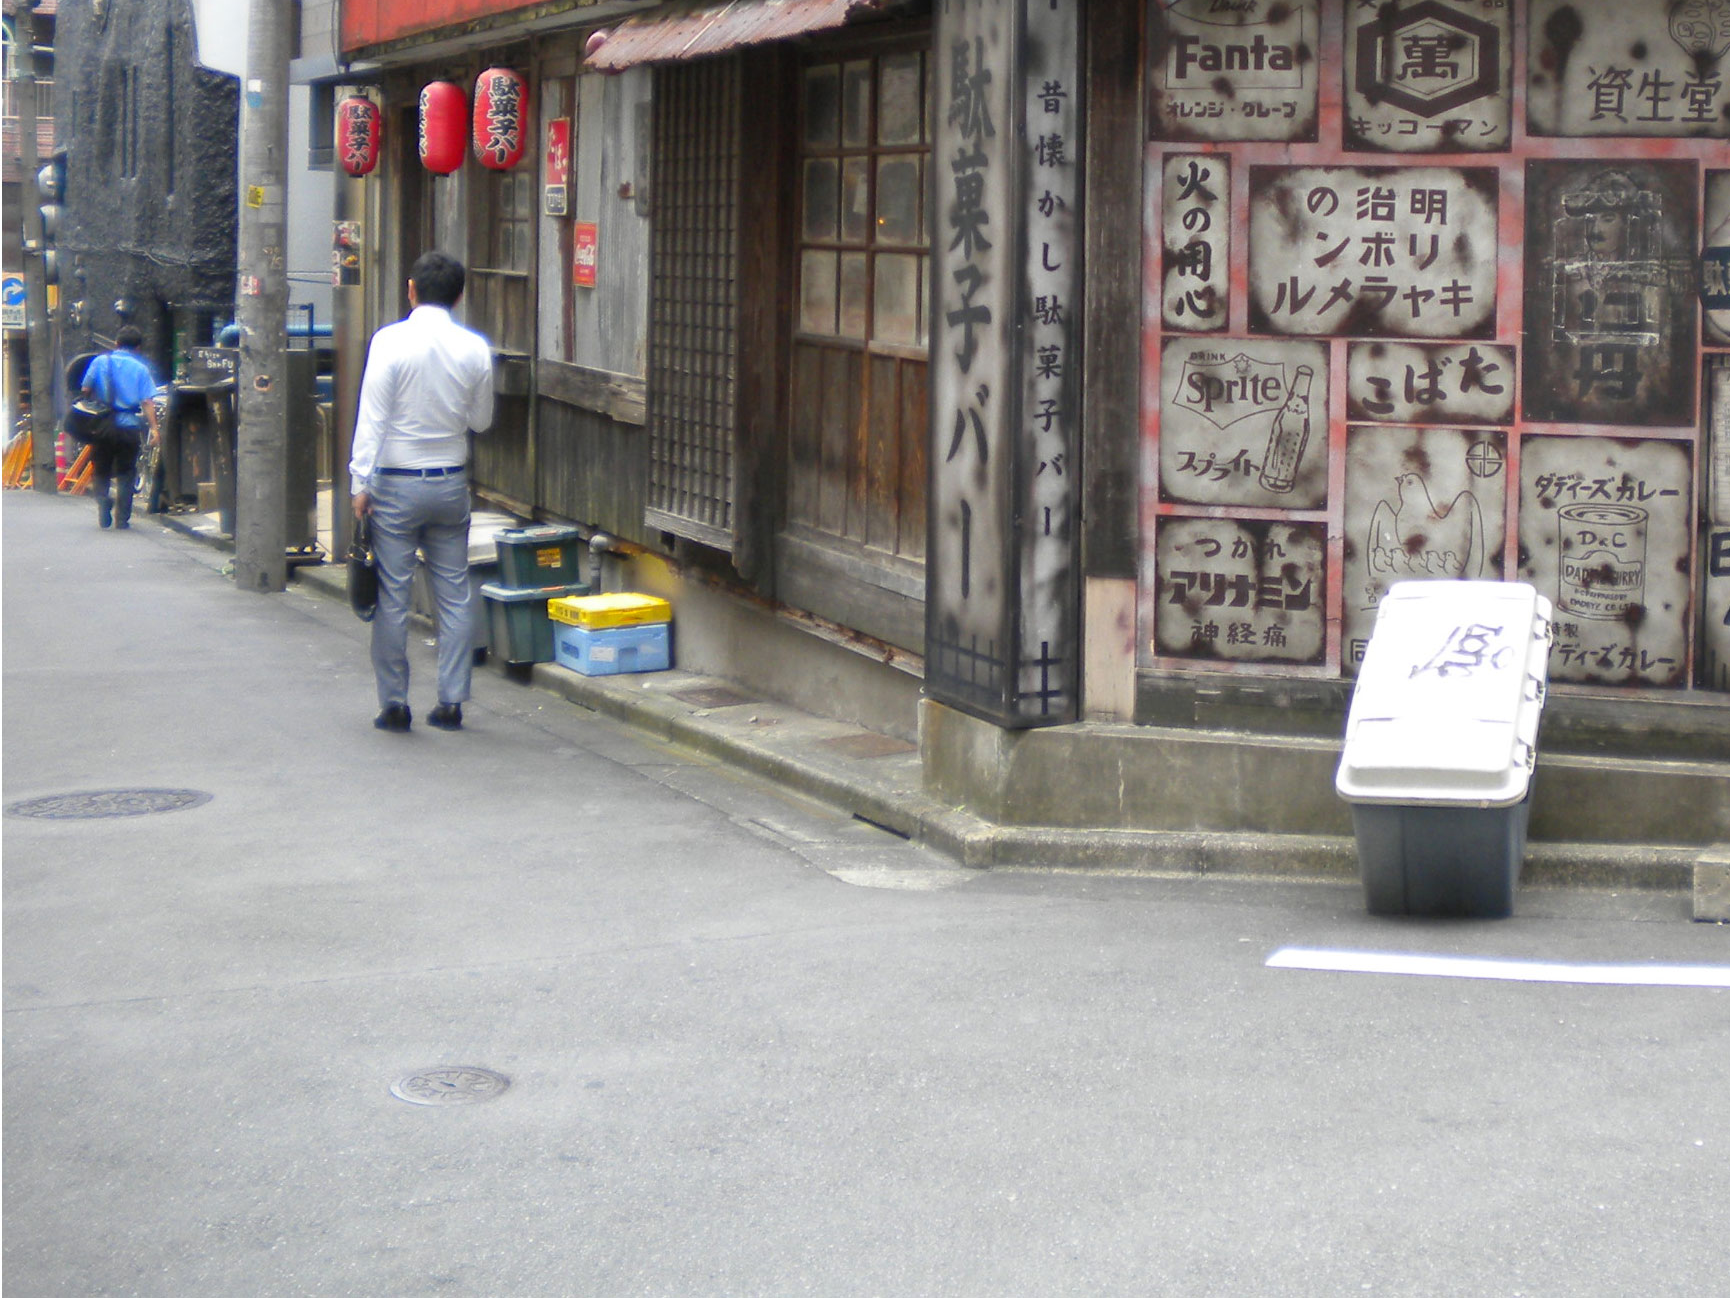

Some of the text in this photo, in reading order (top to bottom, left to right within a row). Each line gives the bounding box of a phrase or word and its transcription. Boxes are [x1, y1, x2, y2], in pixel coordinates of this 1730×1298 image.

[1176, 35, 1293, 79] Fanta
[346, 104, 373, 172] 駄菓子バー
[487, 75, 522, 164] 駄菓子バー
[1353, 116, 1498, 135] キッコーマン
[1176, 160, 1219, 319] 火の用心
[946, 37, 996, 601] 駄菓子バー
[1033, 80, 1068, 537] 昔懐かし駄菓子バー
[1189, 351, 1227, 361] DRINK
[1186, 371, 1282, 413] Sprite
[1176, 448, 1261, 482] スプライト
[1195, 536, 1287, 560] つかれ
[1169, 571, 1313, 611] アリナミン
[1191, 619, 1288, 648] 神経痛
